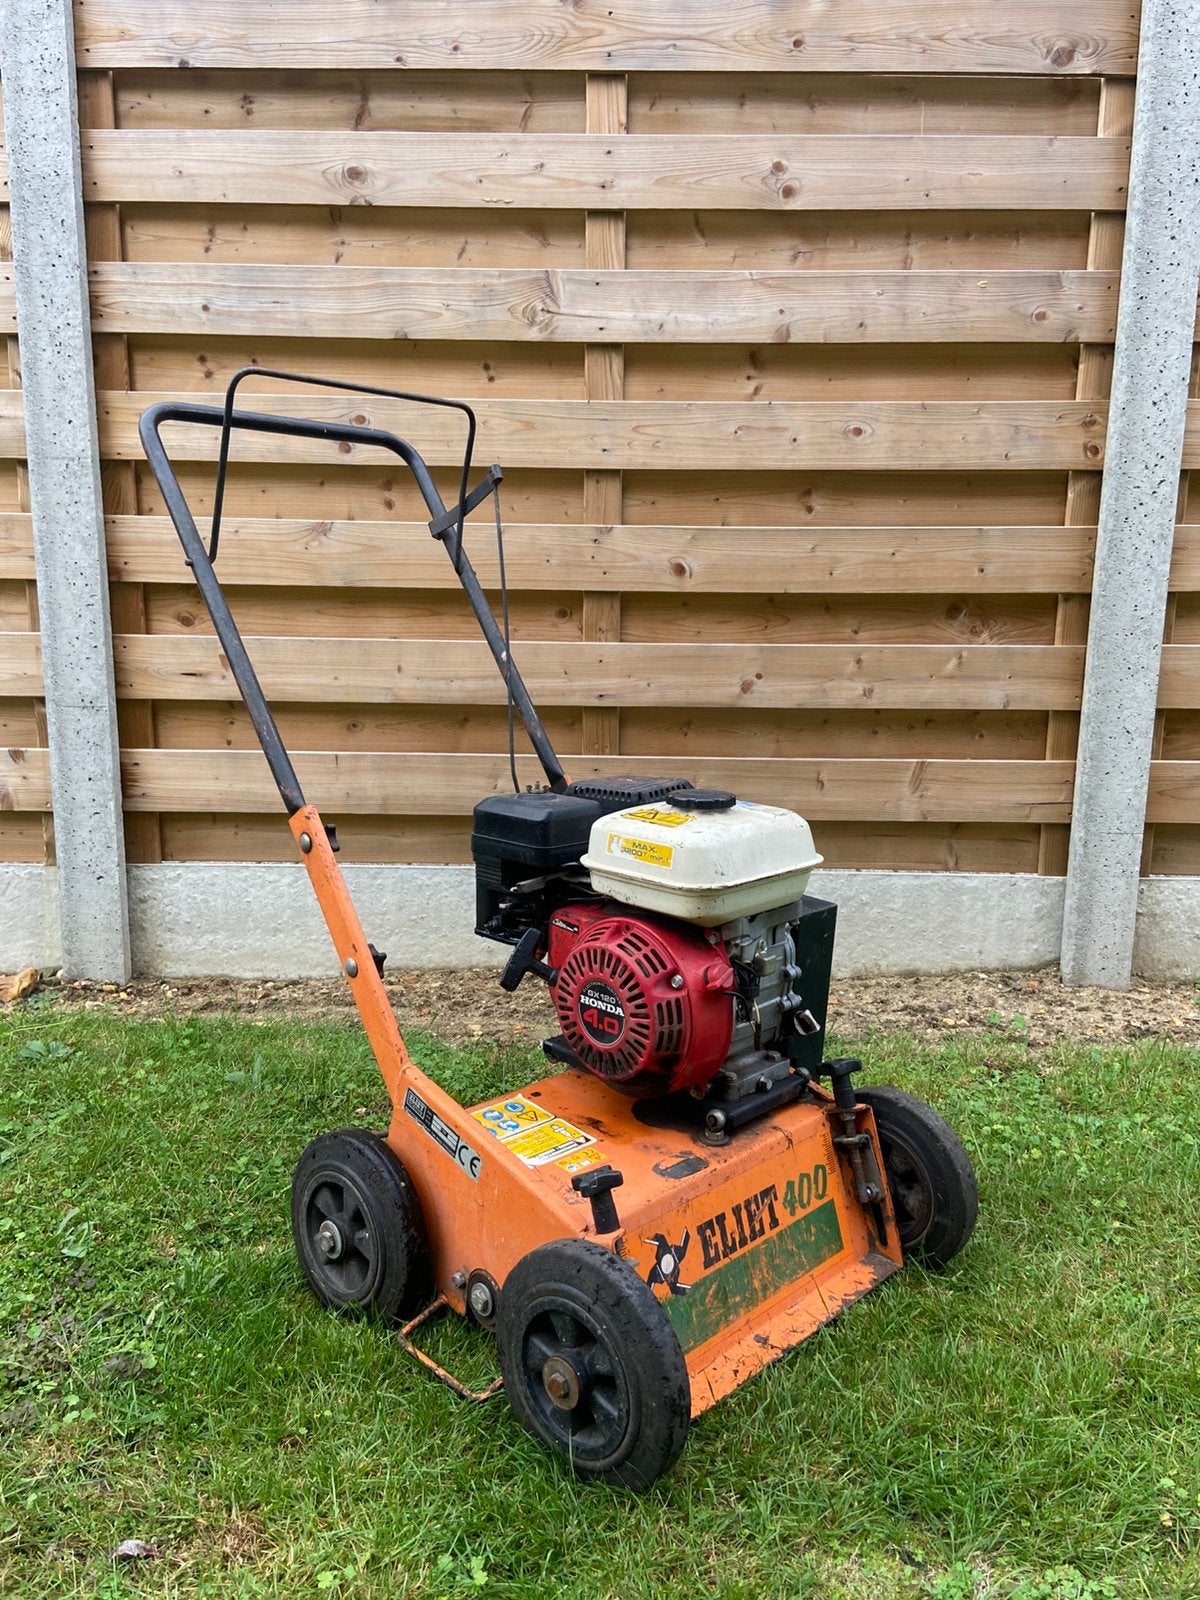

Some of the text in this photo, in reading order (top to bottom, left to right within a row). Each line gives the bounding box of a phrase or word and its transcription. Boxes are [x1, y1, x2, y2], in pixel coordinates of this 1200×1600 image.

[580, 994, 625, 1017] HONDA
[587, 989, 616, 1004] GX120
[583, 1008, 619, 1035] 4.0
[697, 1164, 827, 1270] ELIET 400
